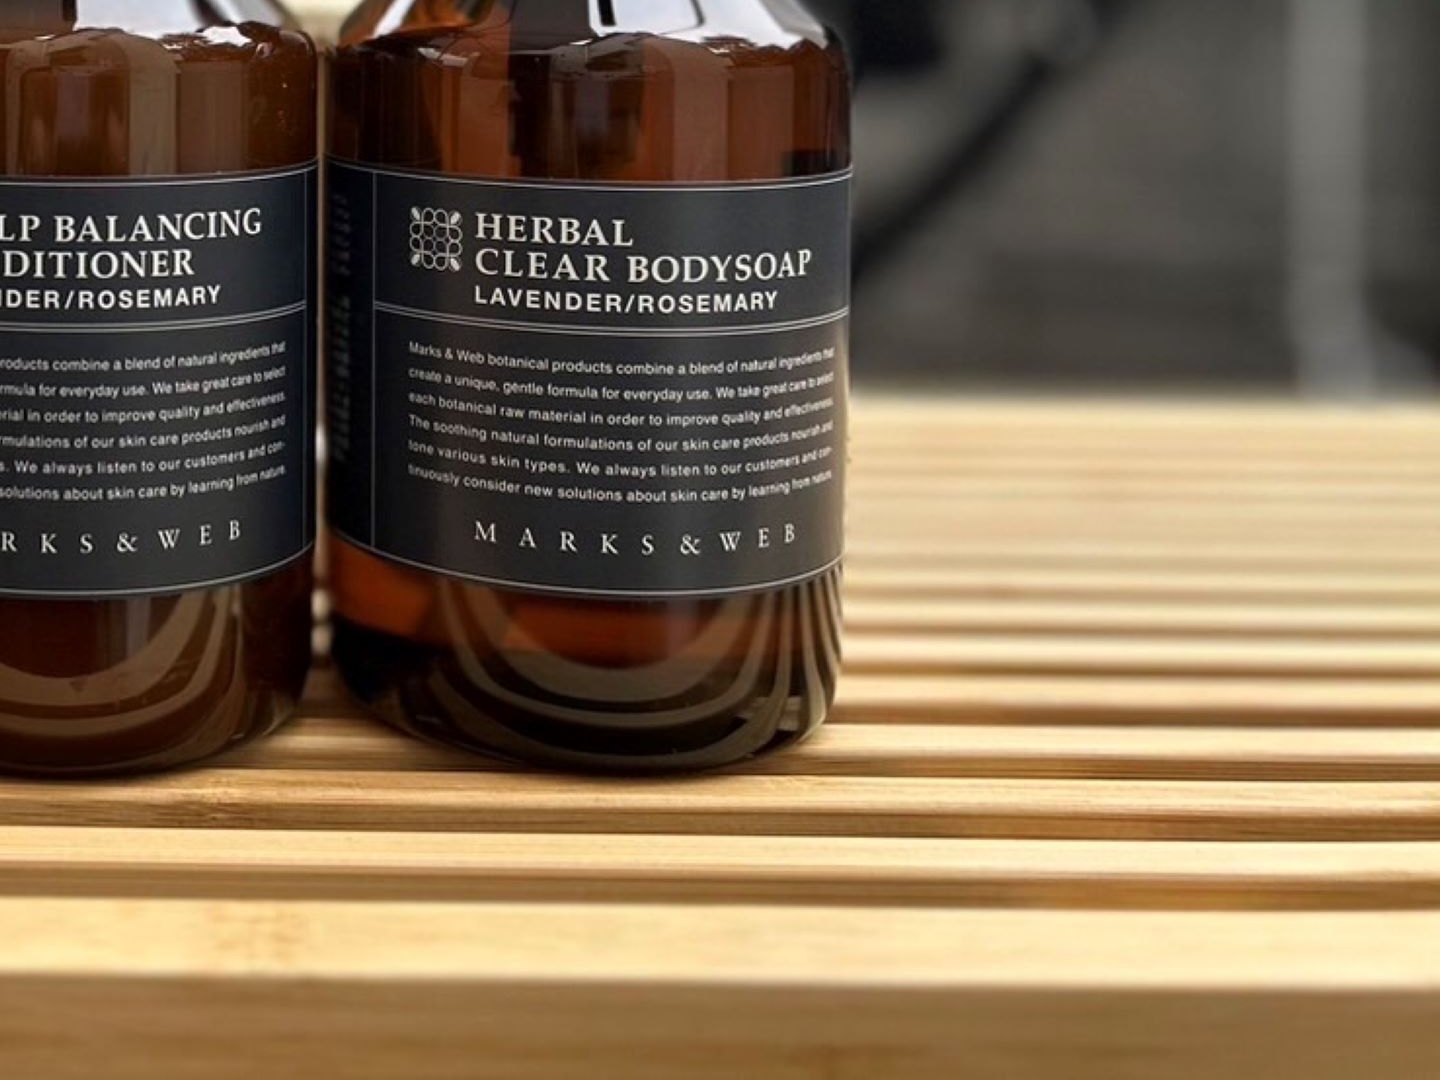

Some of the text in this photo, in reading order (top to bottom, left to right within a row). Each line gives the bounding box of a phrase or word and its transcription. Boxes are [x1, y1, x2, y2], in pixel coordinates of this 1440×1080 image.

[54, 208, 262, 242] BALANCING
[475, 213, 633, 246] HERBAL
[475, 248, 812, 283] CLEAR BODYSOAP
[475, 286, 778, 314] LAVENDER/ROSEMARY
[52, 359, 110, 371] combine
[113, 360, 122, 370] a
[125, 357, 160, 370] blend
[163, 355, 176, 368] of
[178, 352, 217, 367] natural
[445, 348, 738, 375] & Web botanical products combine a blend of
[39, 383, 57, 397] for
[59, 385, 119, 399] everyday
[122, 385, 148, 396] use.
[152, 382, 172, 394] We
[175, 380, 199, 393] take
[445, 374, 451, 384] a
[503, 382, 544, 395] gentle
[547, 383, 598, 399] formula
[602, 387, 620, 399] for
[623, 388, 683, 403] everyday
[686, 390, 712, 400] use.
[716, 387, 735, 398] We
[27, 409, 41, 422] in
[43, 410, 81, 423] order
[85, 411, 98, 423] to
[102, 410, 156, 424] improve
[159, 406, 200, 422] quality
[439, 396, 761, 428] botanical raw material in order to improve quality
[74, 435, 88, 448] of
[91, 437, 114, 448] our
[119, 435, 146, 448] skin
[150, 434, 179, 446] care
[182, 427, 232, 446] products
[433, 422, 740, 452] soothing natural formulations of our skin care
[14, 460, 38, 473] We
[43, 462, 92, 477] always
[98, 462, 137, 474] listen
[141, 461, 155, 472] to
[158, 459, 180, 471] our
[437, 448, 742, 479] various skin types. We always listen to our
[63, 488, 103, 500] about
[107, 487, 135, 500] skin
[138, 486, 167, 498] care
[170, 484, 185, 497] by
[463, 477, 745, 502] consider new solutions about skin care by
